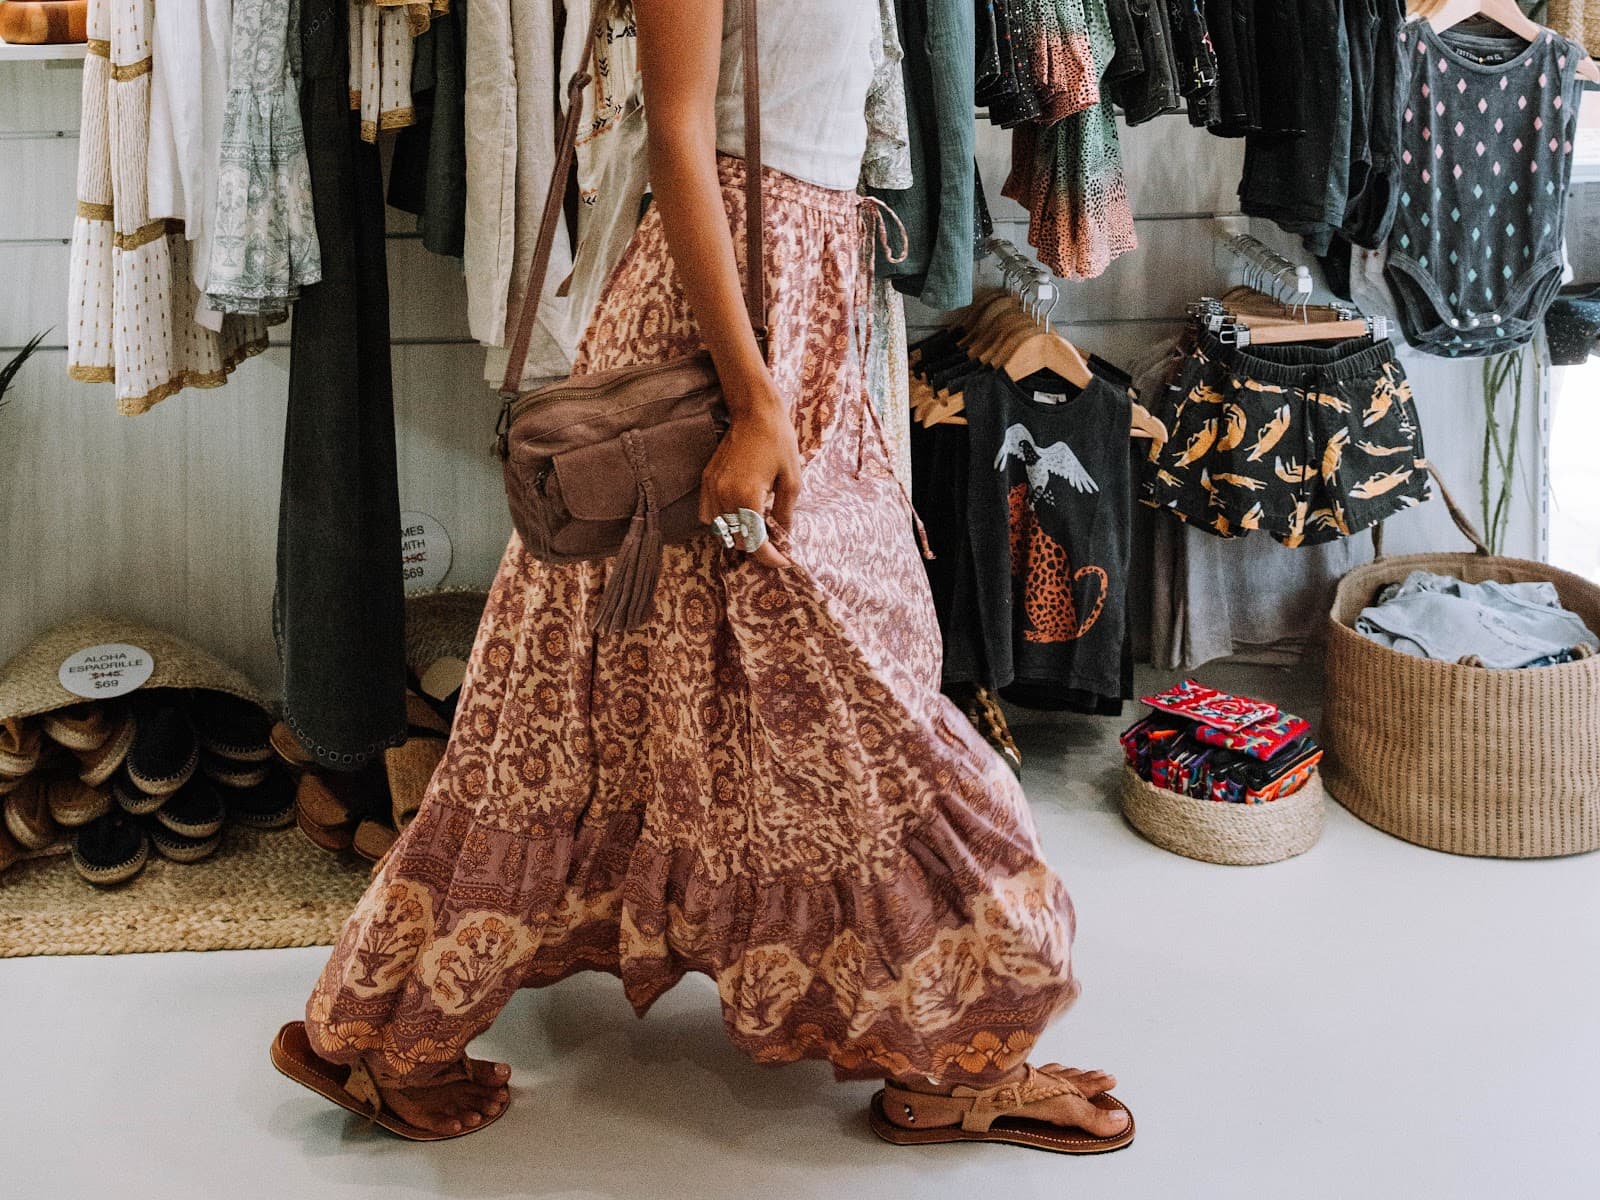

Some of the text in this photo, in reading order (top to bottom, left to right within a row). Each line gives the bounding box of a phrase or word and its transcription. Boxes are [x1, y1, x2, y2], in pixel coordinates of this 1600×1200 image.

[400, 525, 425, 537] MES
[402, 539, 426, 551] MITH
[84, 652, 127, 663] ALOHA
[69, 659, 143, 673] ESPADRILLE
[94, 680, 119, 689] $69
